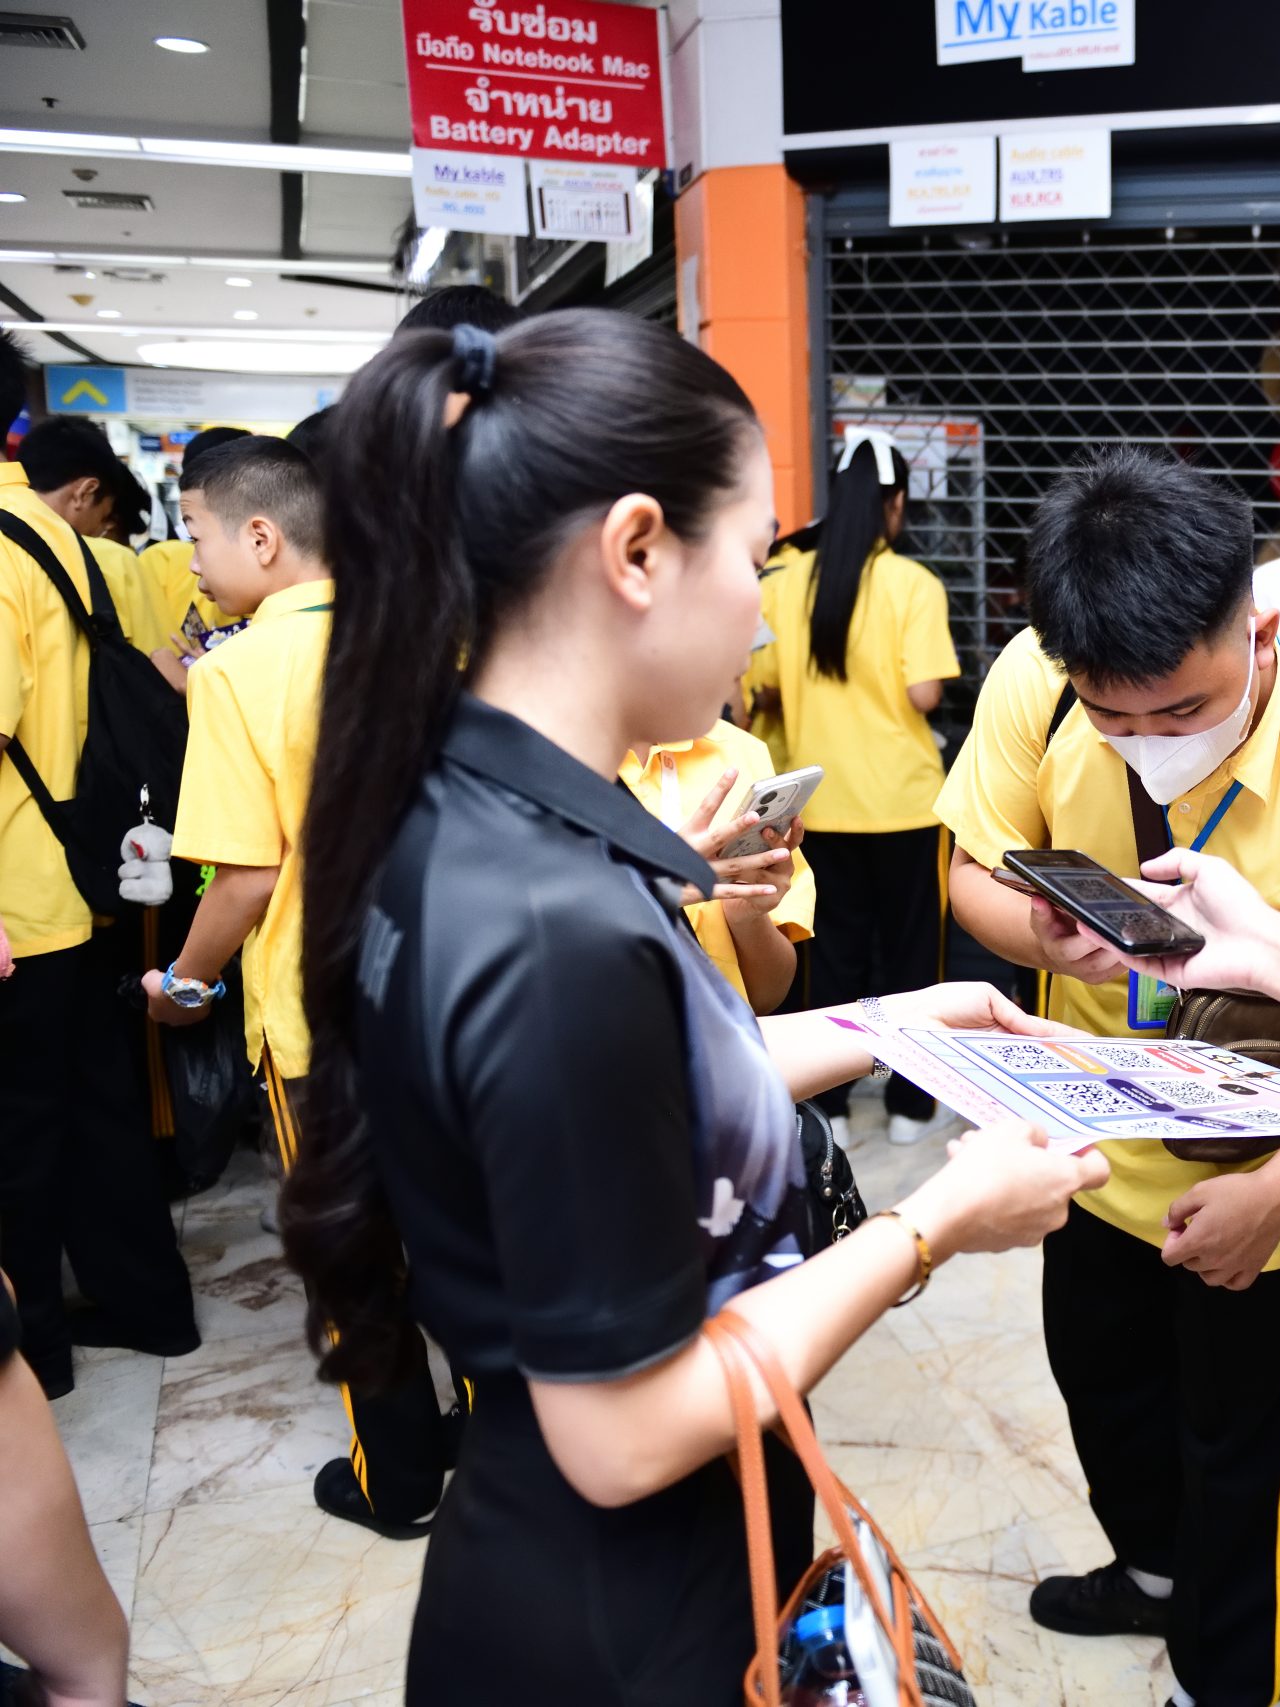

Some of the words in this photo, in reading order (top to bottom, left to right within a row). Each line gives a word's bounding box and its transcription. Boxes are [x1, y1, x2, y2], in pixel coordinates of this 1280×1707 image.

[955, 0, 1019, 39] My
[416, 33, 475, 61] มือถือ
[482, 42, 595, 73] Notebook
[602, 55, 651, 79] Mac
[464, 76, 613, 124] จำหน่าย
[430, 115, 534, 151] Battery
[544, 125, 651, 156] Adapter
[433, 163, 459, 181] My
